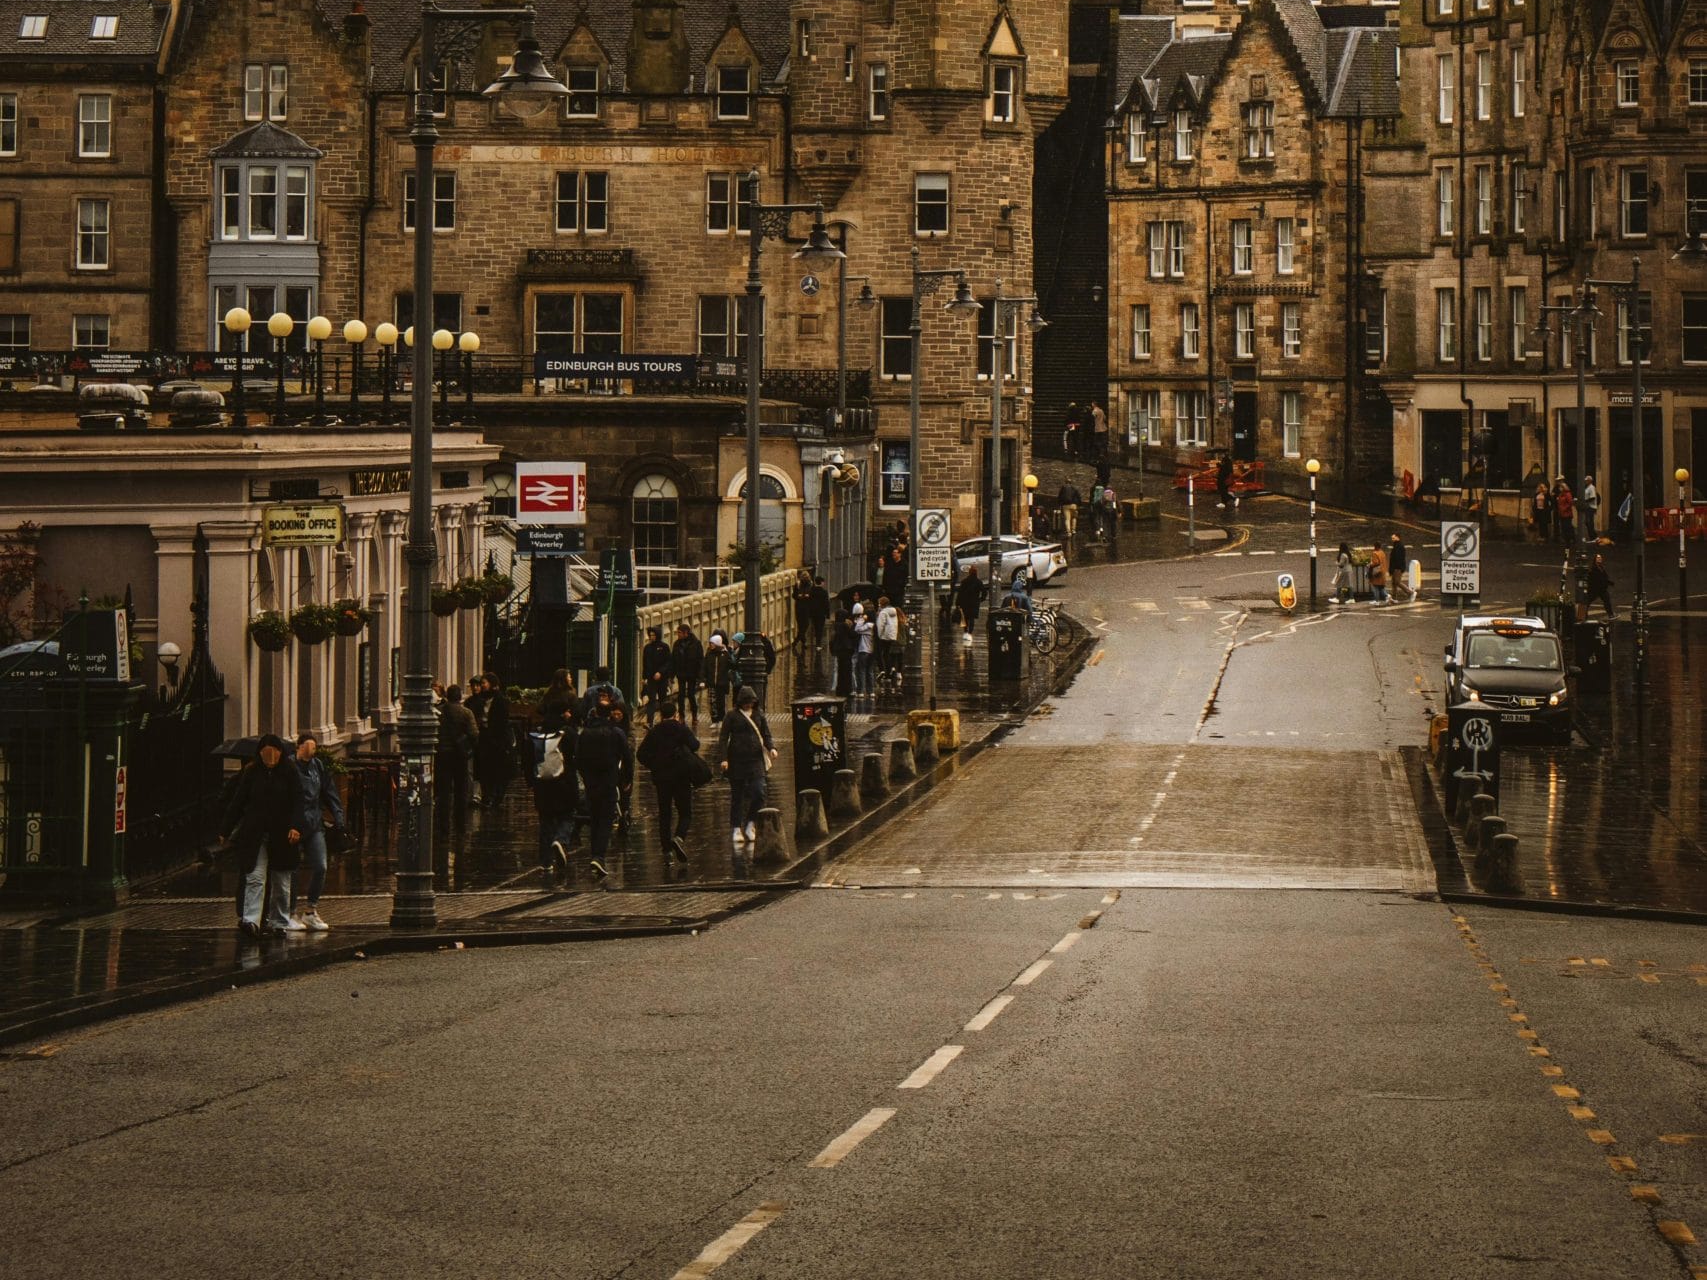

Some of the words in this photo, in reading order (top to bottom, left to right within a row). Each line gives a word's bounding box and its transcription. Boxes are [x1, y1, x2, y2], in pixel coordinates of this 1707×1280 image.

[495, 147, 633, 161] COCKBURN
[545, 361, 615, 371] EDINBURGH
[617, 362, 640, 371] BUS
[643, 362, 683, 372] TOURS
[269, 519, 306, 530] BOOKING
[308, 519, 337, 529] OFFICE
[529, 531, 564, 541] Edinburgh
[920, 569, 946, 577] ENDS
[1446, 582, 1474, 591] ENDS
